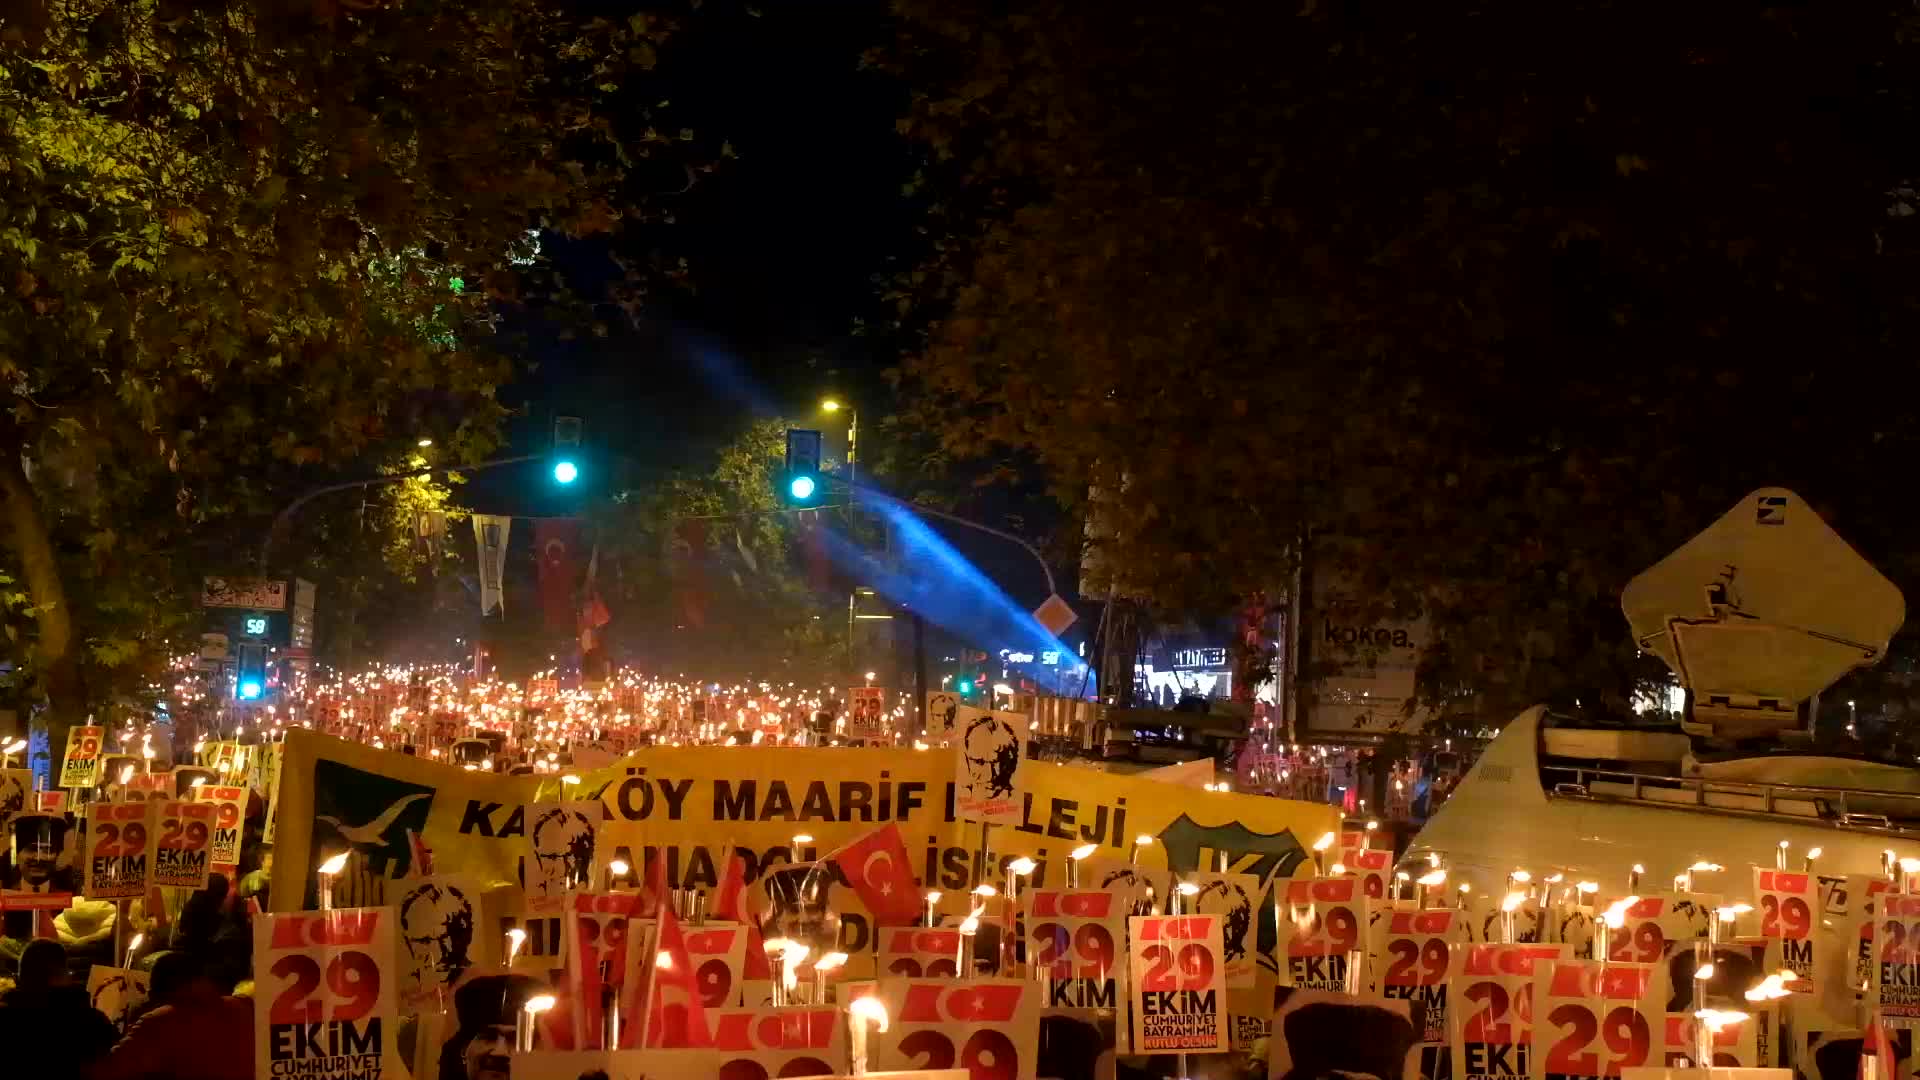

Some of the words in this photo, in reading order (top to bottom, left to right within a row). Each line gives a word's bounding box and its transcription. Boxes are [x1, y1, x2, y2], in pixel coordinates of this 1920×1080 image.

[713, 770, 926, 822] MAARİF
[95, 822, 147, 857] 29
[158, 819, 208, 850] 29
[1761, 894, 1811, 941] 29
[1032, 923, 1115, 979] 29
[1140, 943, 1215, 992] 29
[1384, 938, 1449, 987] 29
[270, 951, 380, 1025] 29
[1050, 978, 1116, 1008] KİM
[1142, 989, 1216, 1015] EKİM
[270, 1016, 382, 1060] EKİM
[1144, 1013, 1216, 1026] CUMHURİYET
[1144, 1024, 1217, 1037] BAYRAMIMIZ
[1145, 1038, 1178, 1050] KUTLU
[1182, 1035, 1217, 1048] OLSUN
[1544, 1004, 1650, 1077] 29
[271, 1053, 382, 1076] CUMHURİYET
